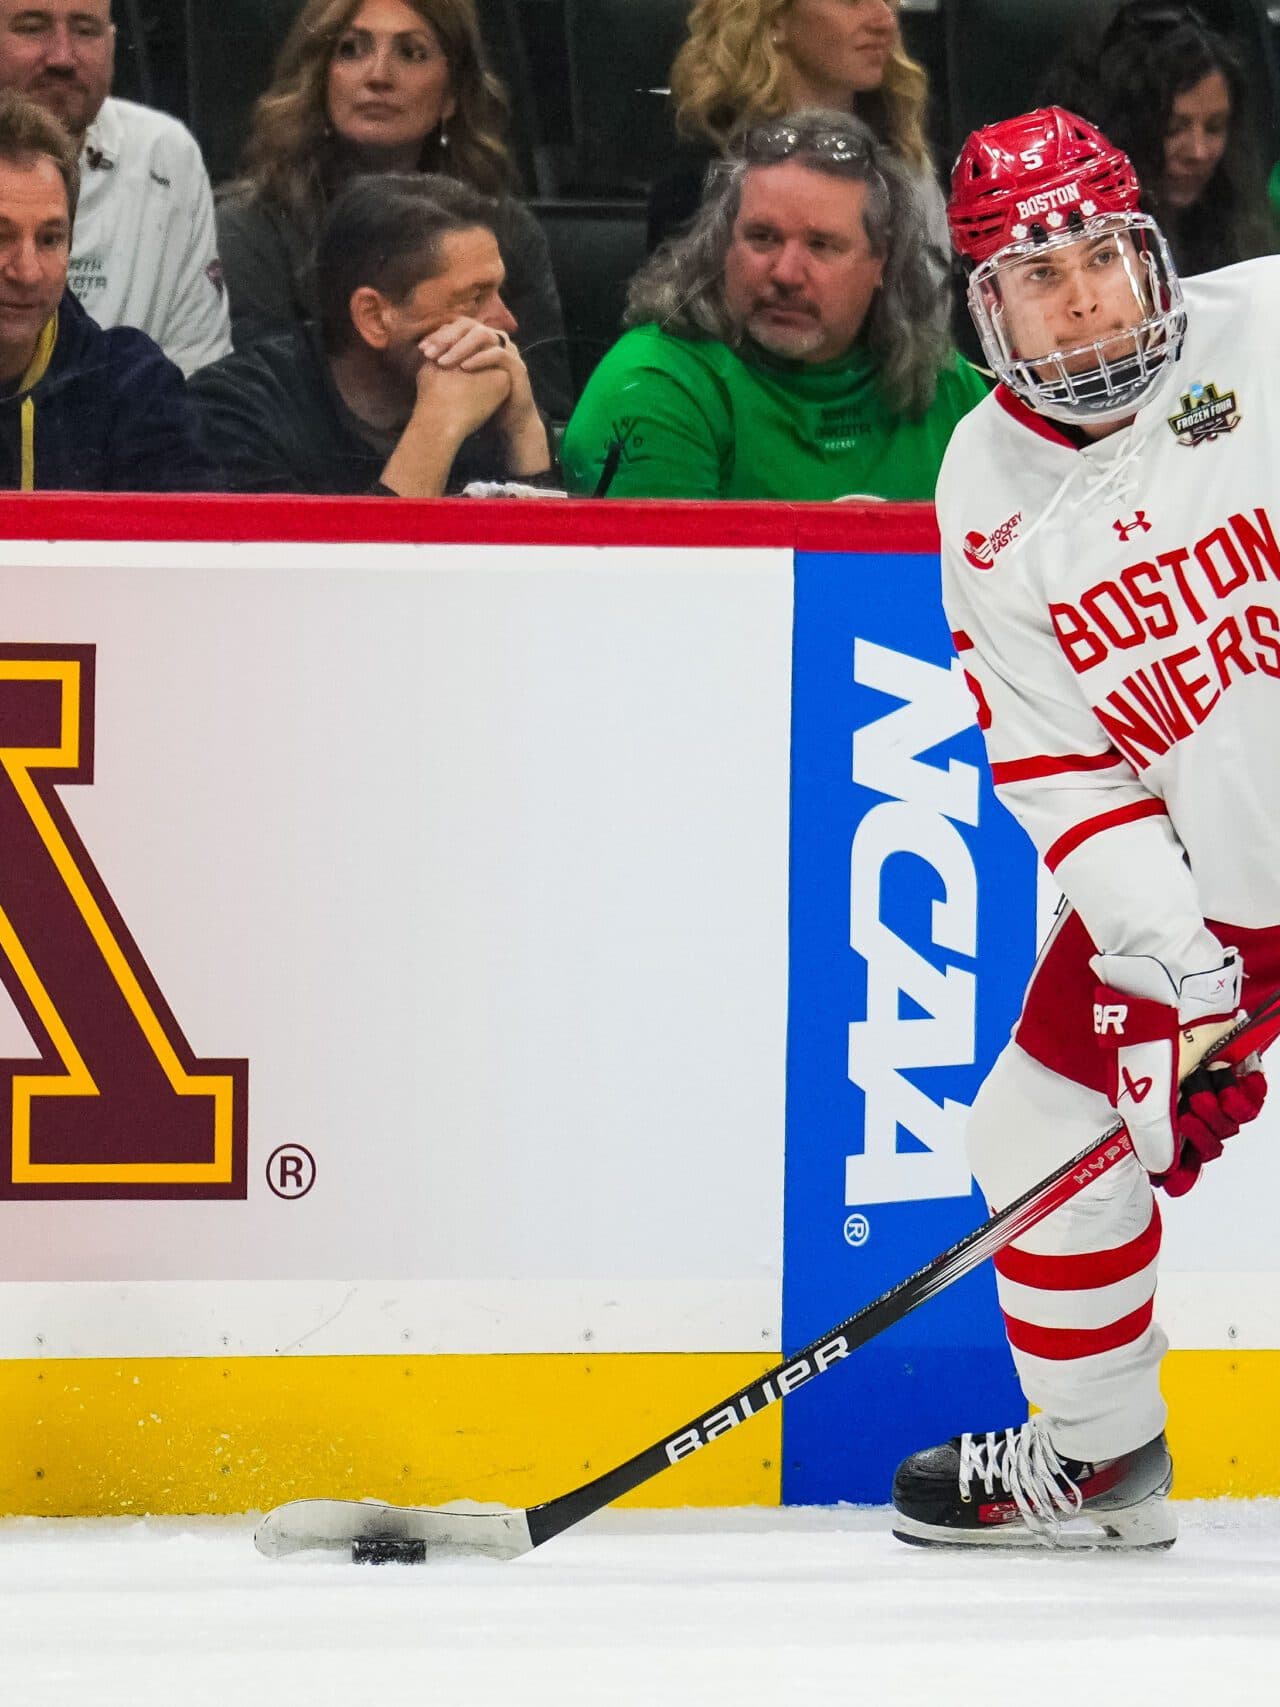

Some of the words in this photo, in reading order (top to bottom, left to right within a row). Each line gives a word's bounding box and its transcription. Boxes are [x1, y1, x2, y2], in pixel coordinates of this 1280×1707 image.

[1020, 149, 1044, 170] 5
[1015, 182, 1081, 220] BOSTON
[1176, 409, 1210, 431] FROZEN
[1211, 398, 1233, 417] FOUR
[989, 512, 1022, 543] HOCKEY
[845, 637, 980, 1207] NCAA
[665, 1335, 851, 1466] BAUER
